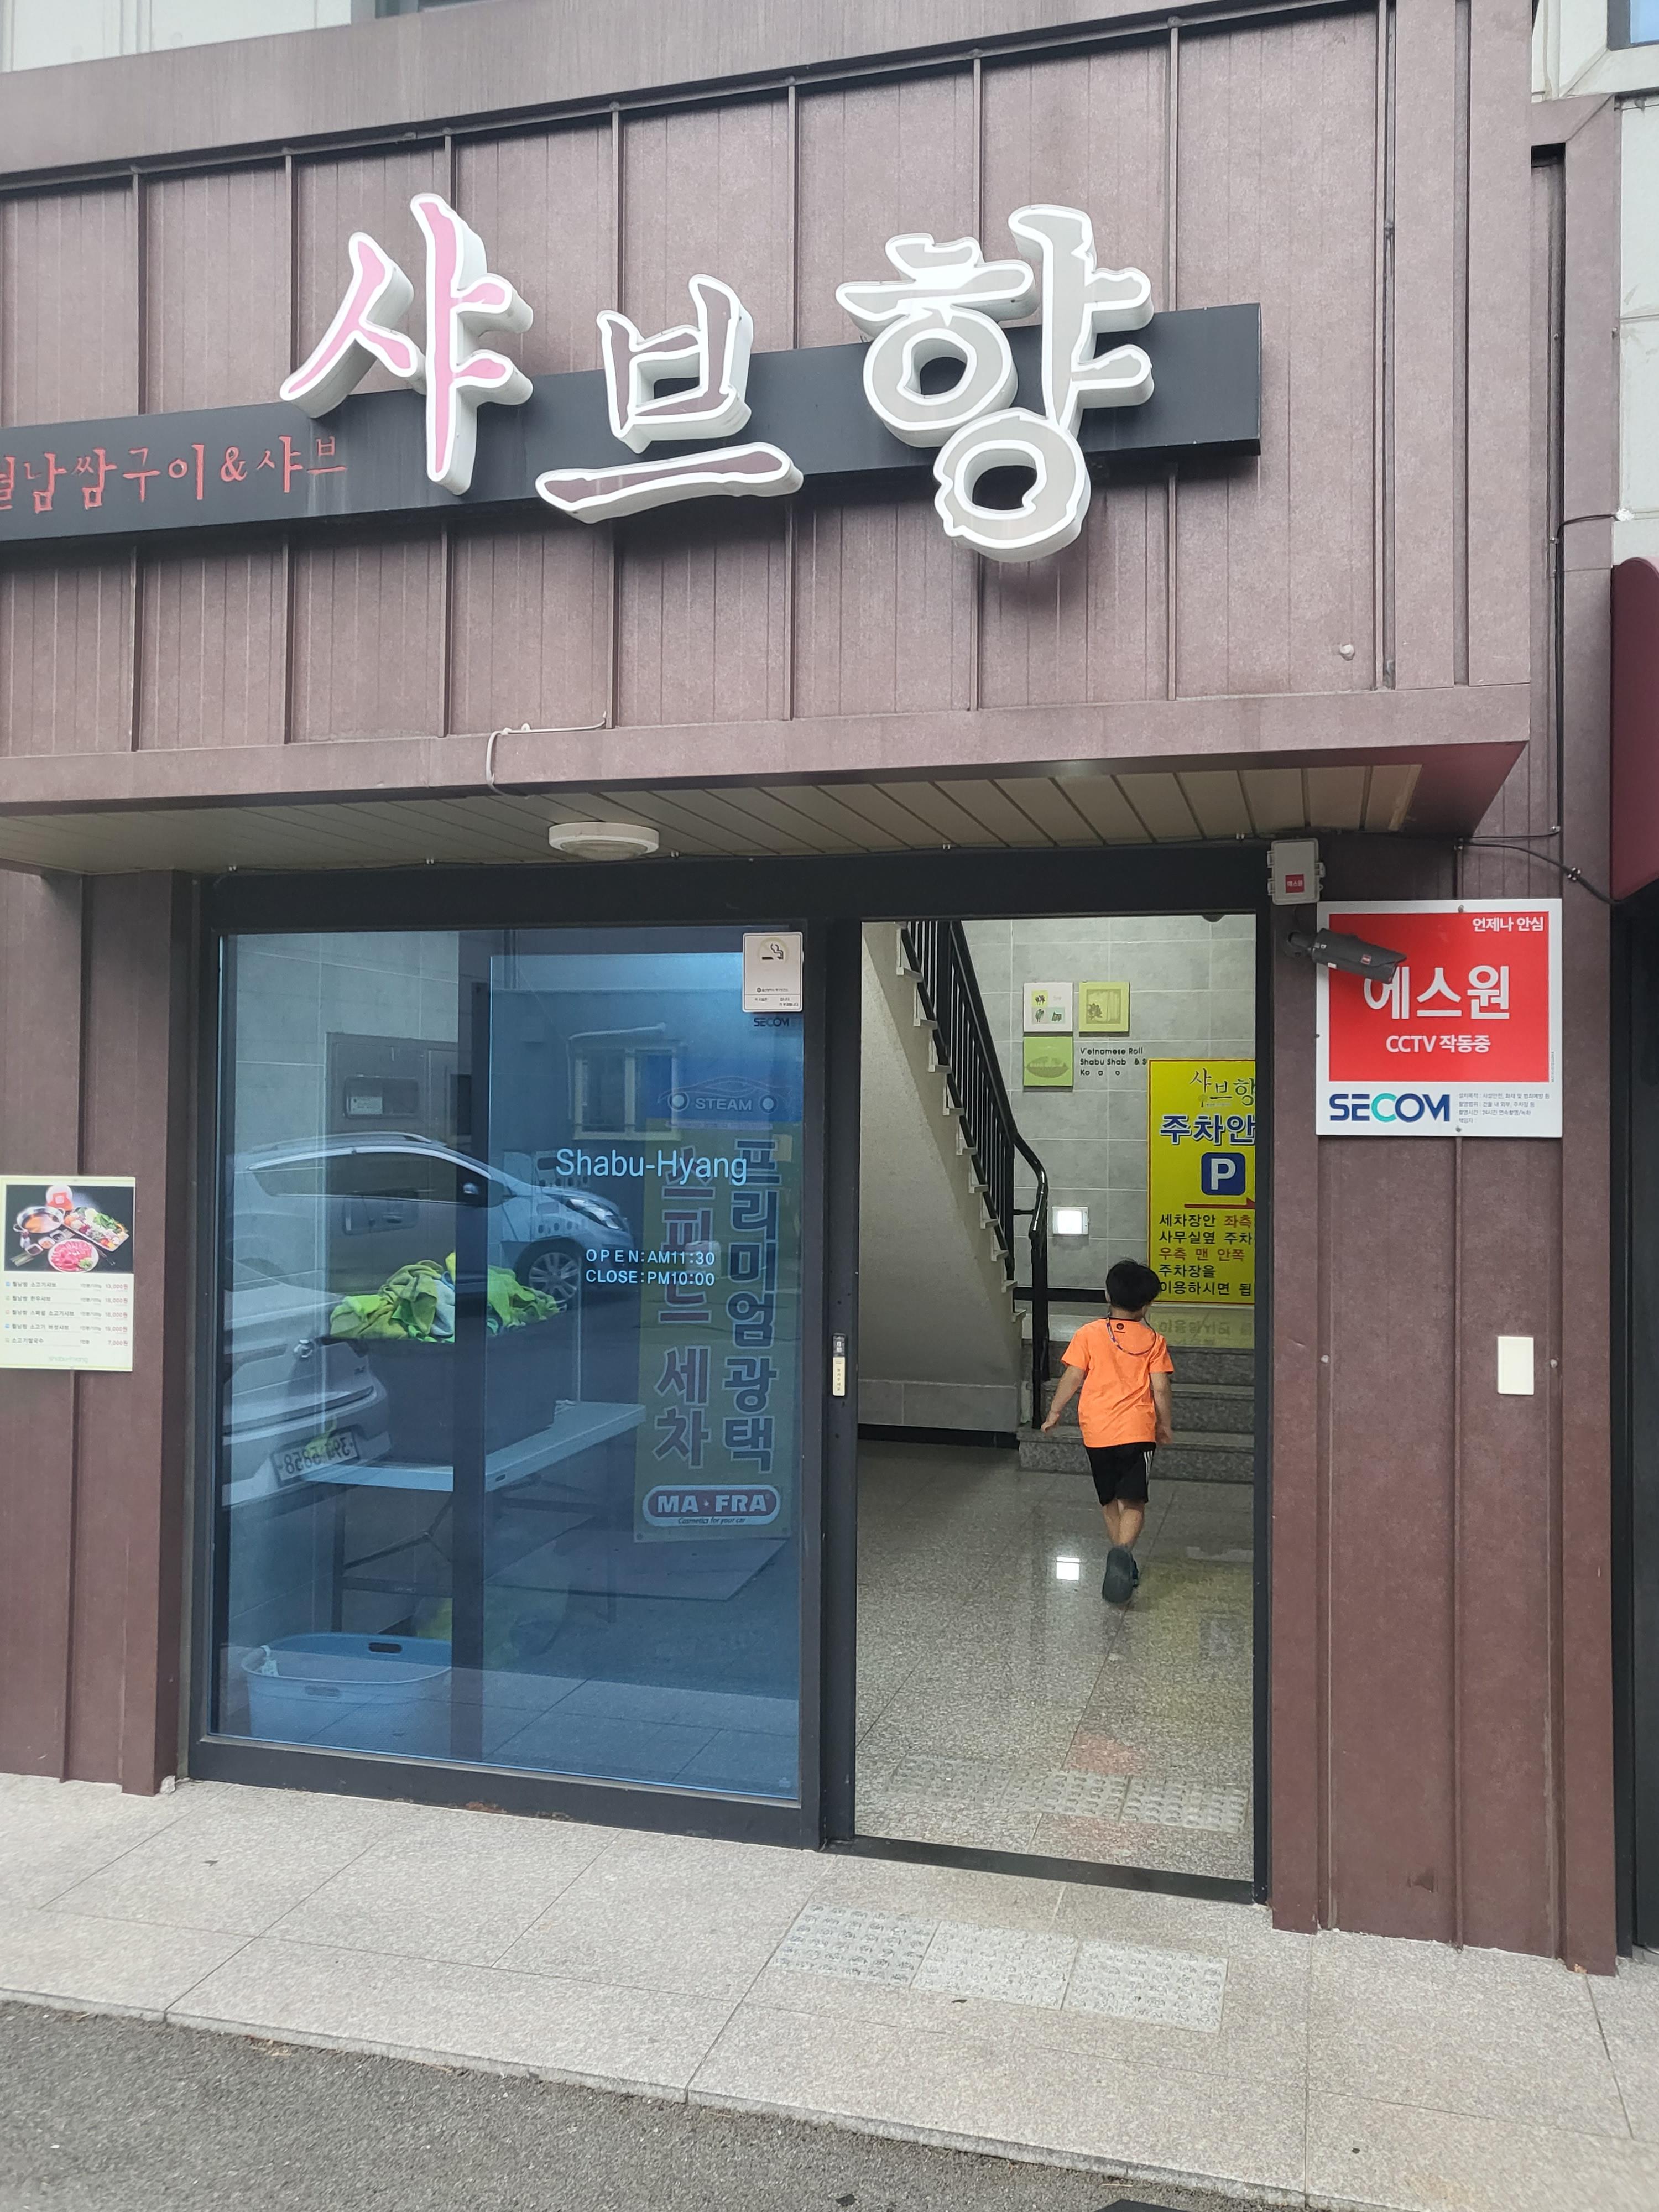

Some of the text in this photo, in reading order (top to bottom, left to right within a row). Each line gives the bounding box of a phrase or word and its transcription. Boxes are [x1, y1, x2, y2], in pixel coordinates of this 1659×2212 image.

[280, 192, 1154, 562] 샤브향
[1472, 916, 1544, 932] 언제나 안심
[1364, 965, 1510, 1019] 에스원
[754, 1018, 790, 1027] SECOM
[1386, 1034, 1491, 1053] CCTV 작동중
[695, 1098, 752, 1112] STEAM
[1329, 1093, 1451, 1123] SECOM
[556, 1149, 747, 1186] Shabu-Hyang
[1210, 1157, 1237, 1191] P
[1159, 1214, 1252, 1228] 세차장안 좌측
[1159, 1230, 1215, 1244] 사무실옆
[1159, 1247, 1245, 1262] 우측 맨 안쪽
[1159, 1264, 1216, 1278] 주차장을
[1160, 1281, 1230, 1296] 이용하시면
[652, 1345, 712, 1469] 세차
[722, 1355, 778, 1474] 광택
